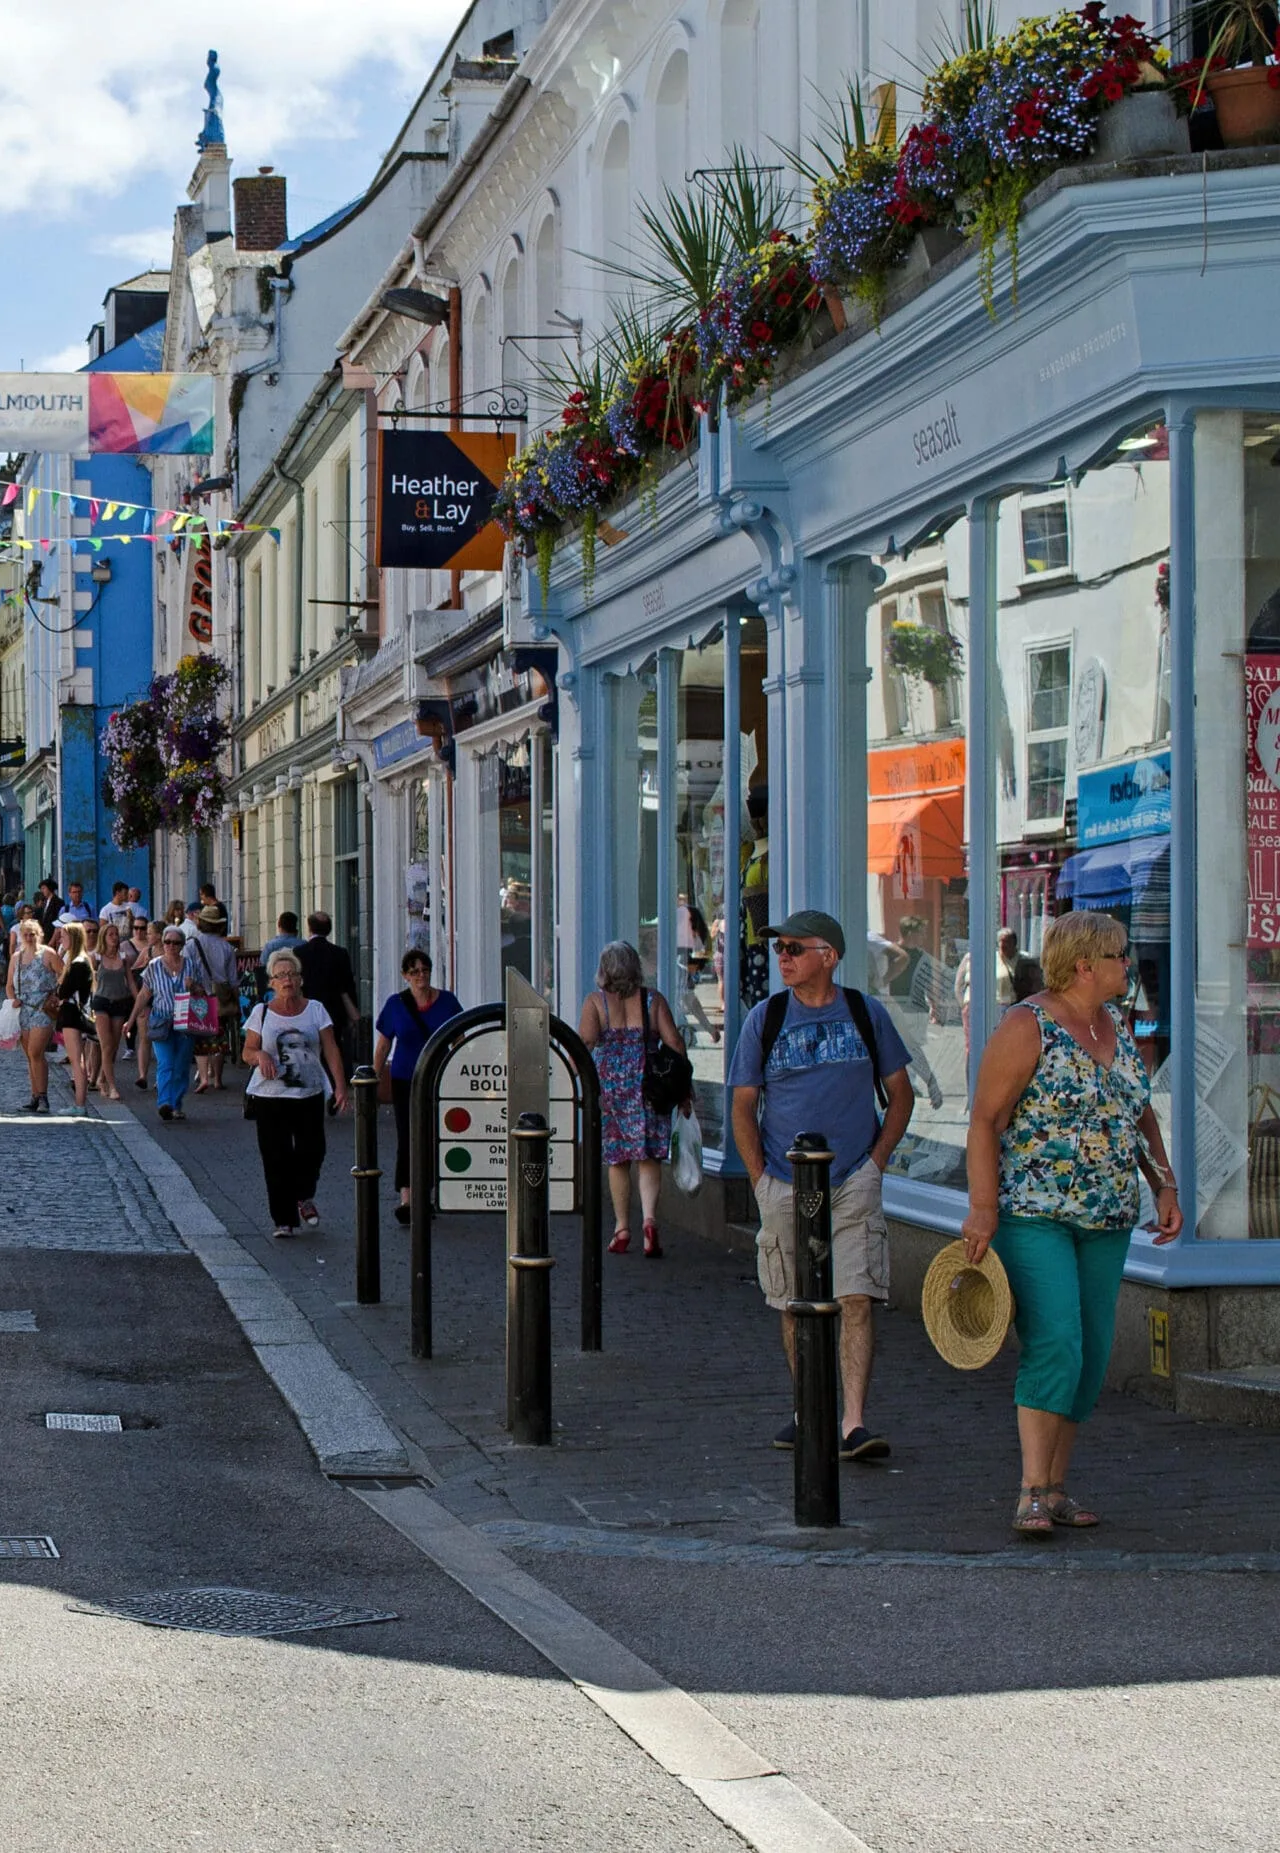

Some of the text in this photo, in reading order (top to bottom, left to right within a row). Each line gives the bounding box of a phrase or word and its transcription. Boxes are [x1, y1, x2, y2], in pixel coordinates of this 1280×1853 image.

[913, 400, 961, 467] seasalt
[391, 474, 479, 496] Heather
[415, 499, 471, 525] & Lay
